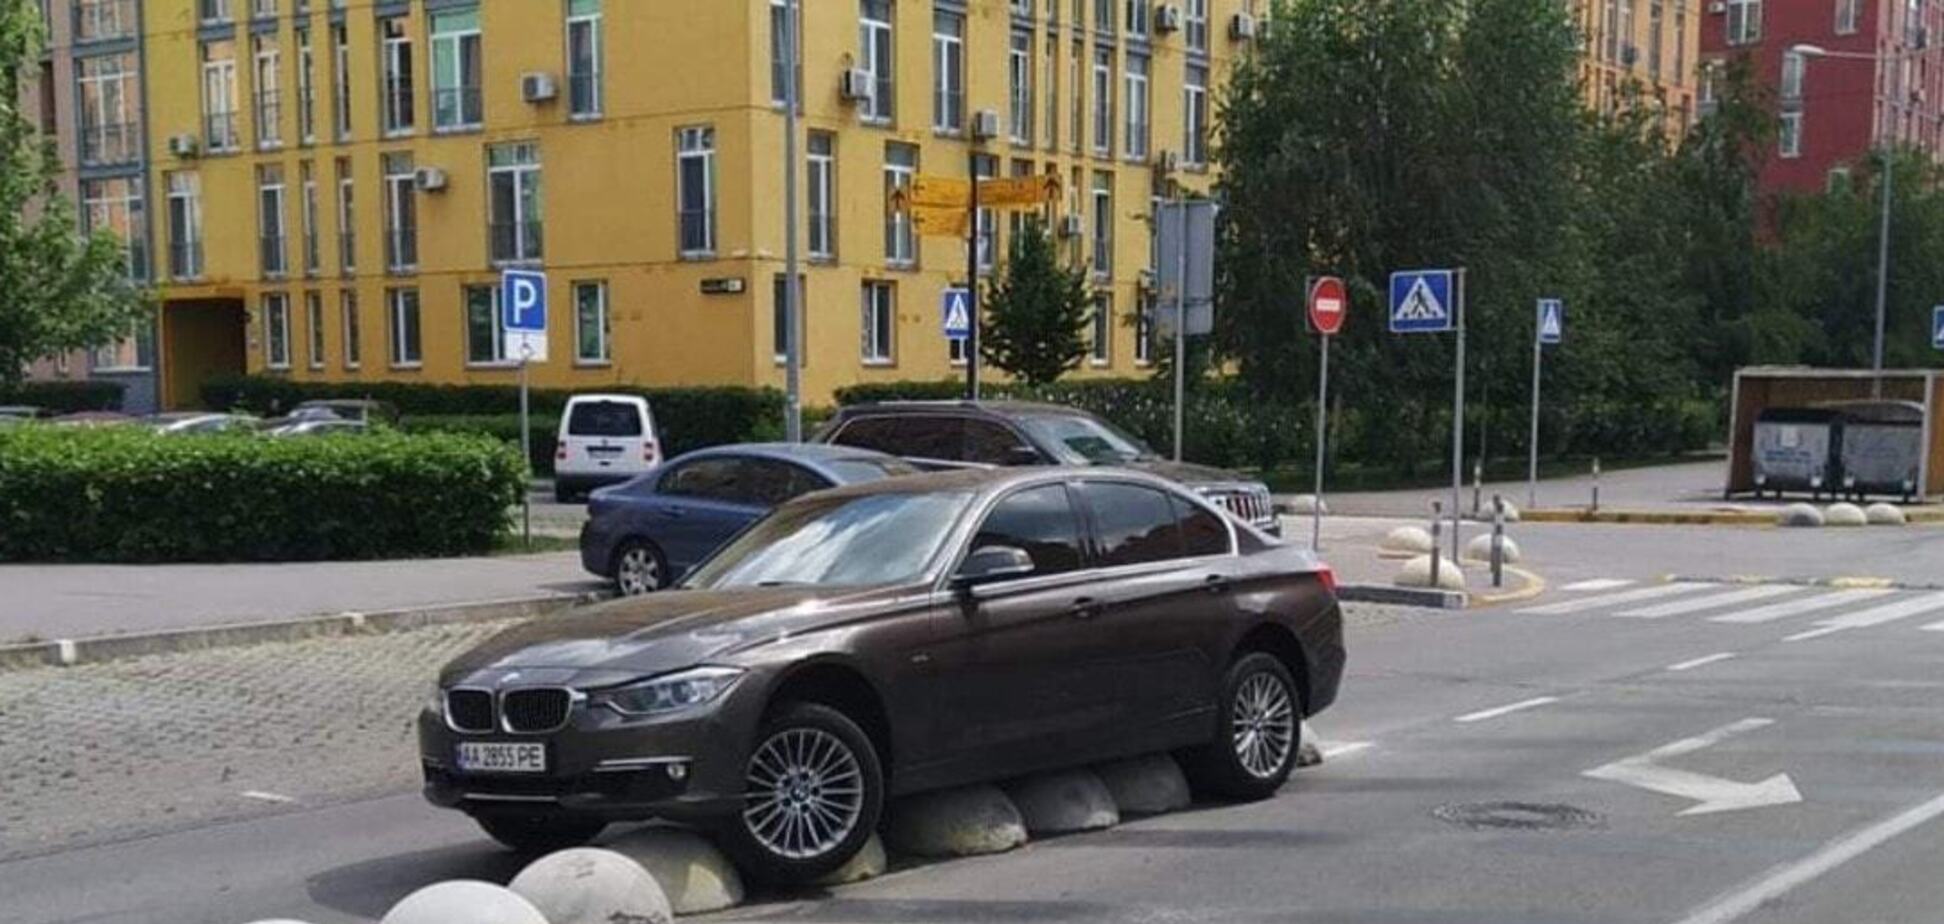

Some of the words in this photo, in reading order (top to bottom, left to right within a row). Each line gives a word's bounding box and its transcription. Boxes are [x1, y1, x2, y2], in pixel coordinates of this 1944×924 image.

[513, 279, 537, 324] P
[462, 745, 481, 765] AA
[517, 746, 541, 768] PE
